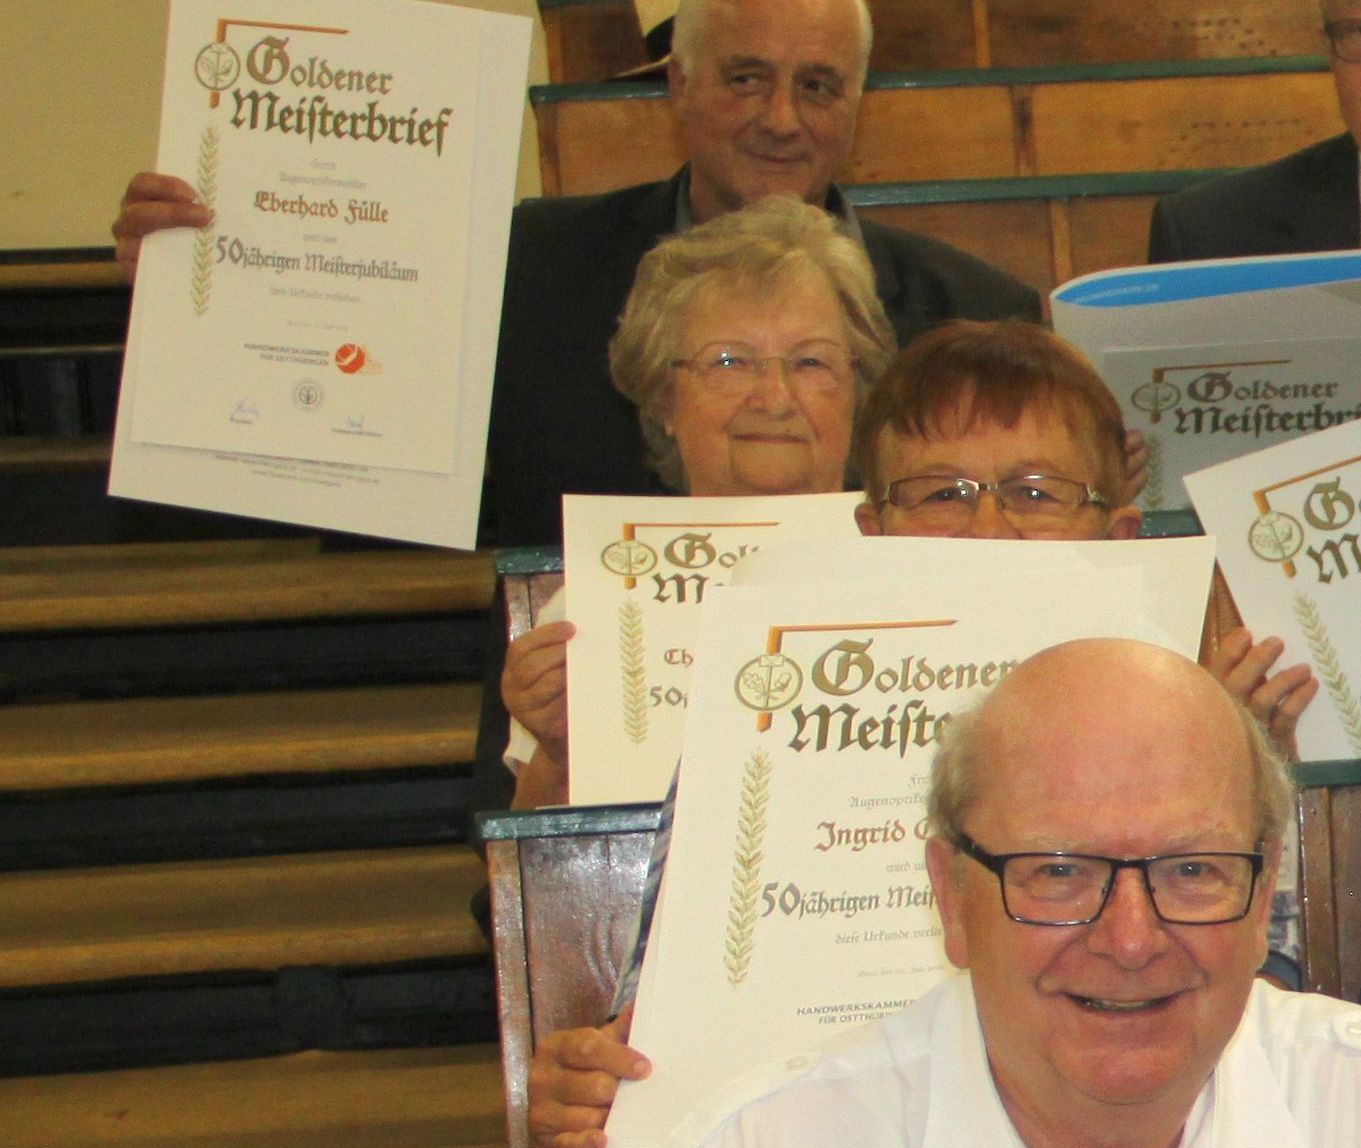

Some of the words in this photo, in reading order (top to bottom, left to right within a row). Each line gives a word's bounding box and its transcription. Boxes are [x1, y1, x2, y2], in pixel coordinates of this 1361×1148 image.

[246, 36, 394, 95] Goldener
[255, 190, 338, 220] Eberhard
[343, 199, 390, 224] Fülle
[216, 235, 300, 274] 50jährigen
[1187, 371, 1339, 403] Goldener
[815, 819, 906, 852] Ingrid
[761, 882, 880, 920] 50jährigen
